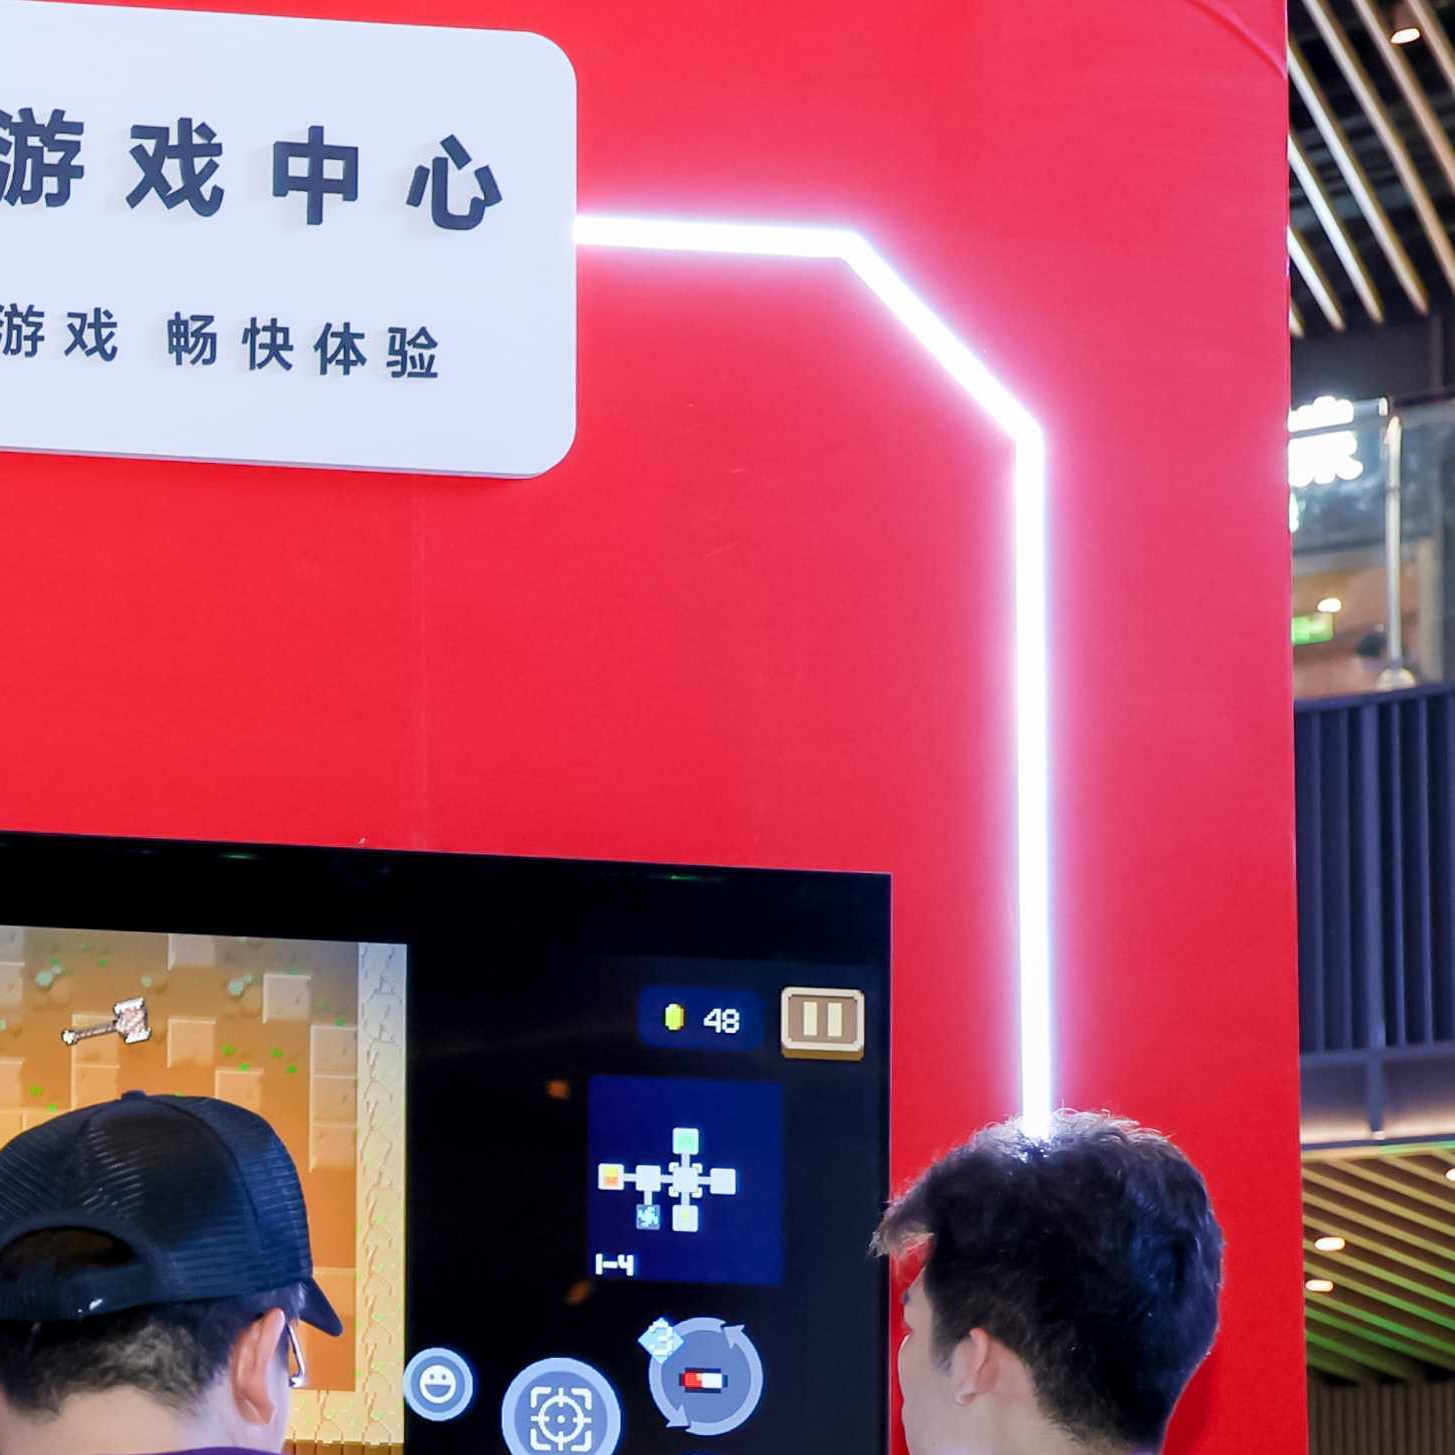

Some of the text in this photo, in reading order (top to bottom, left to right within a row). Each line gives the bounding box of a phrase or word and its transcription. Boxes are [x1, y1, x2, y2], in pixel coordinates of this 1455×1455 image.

[166, 310, 439, 381] 畅快体验
[703, 1008, 740, 1033] 48
